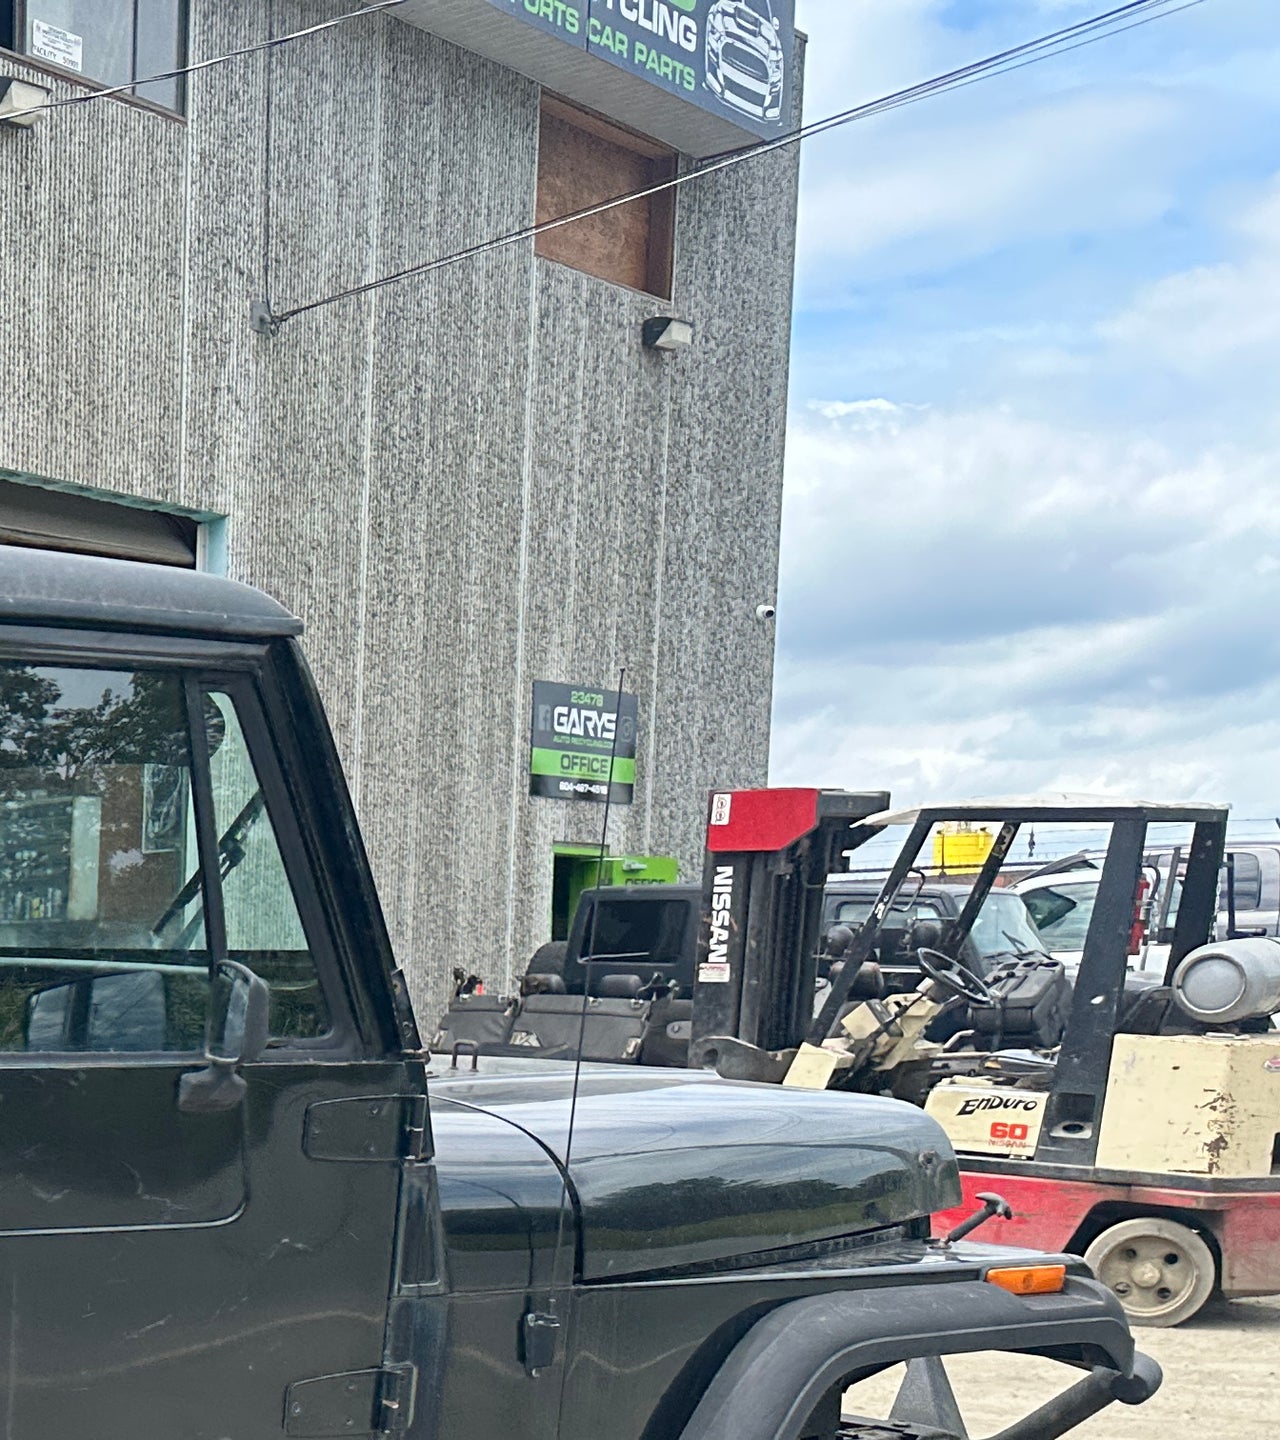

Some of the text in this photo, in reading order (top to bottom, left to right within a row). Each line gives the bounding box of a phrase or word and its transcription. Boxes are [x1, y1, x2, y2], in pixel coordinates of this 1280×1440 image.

[523, 0, 695, 91] ORTS CAR PARTS
[606, 0, 697, 53] CLING
[553, 706, 617, 740] GARYS
[560, 754, 609, 774] OFFICE
[708, 865, 734, 962] NISSAN
[990, 1122, 1029, 1140] 60
